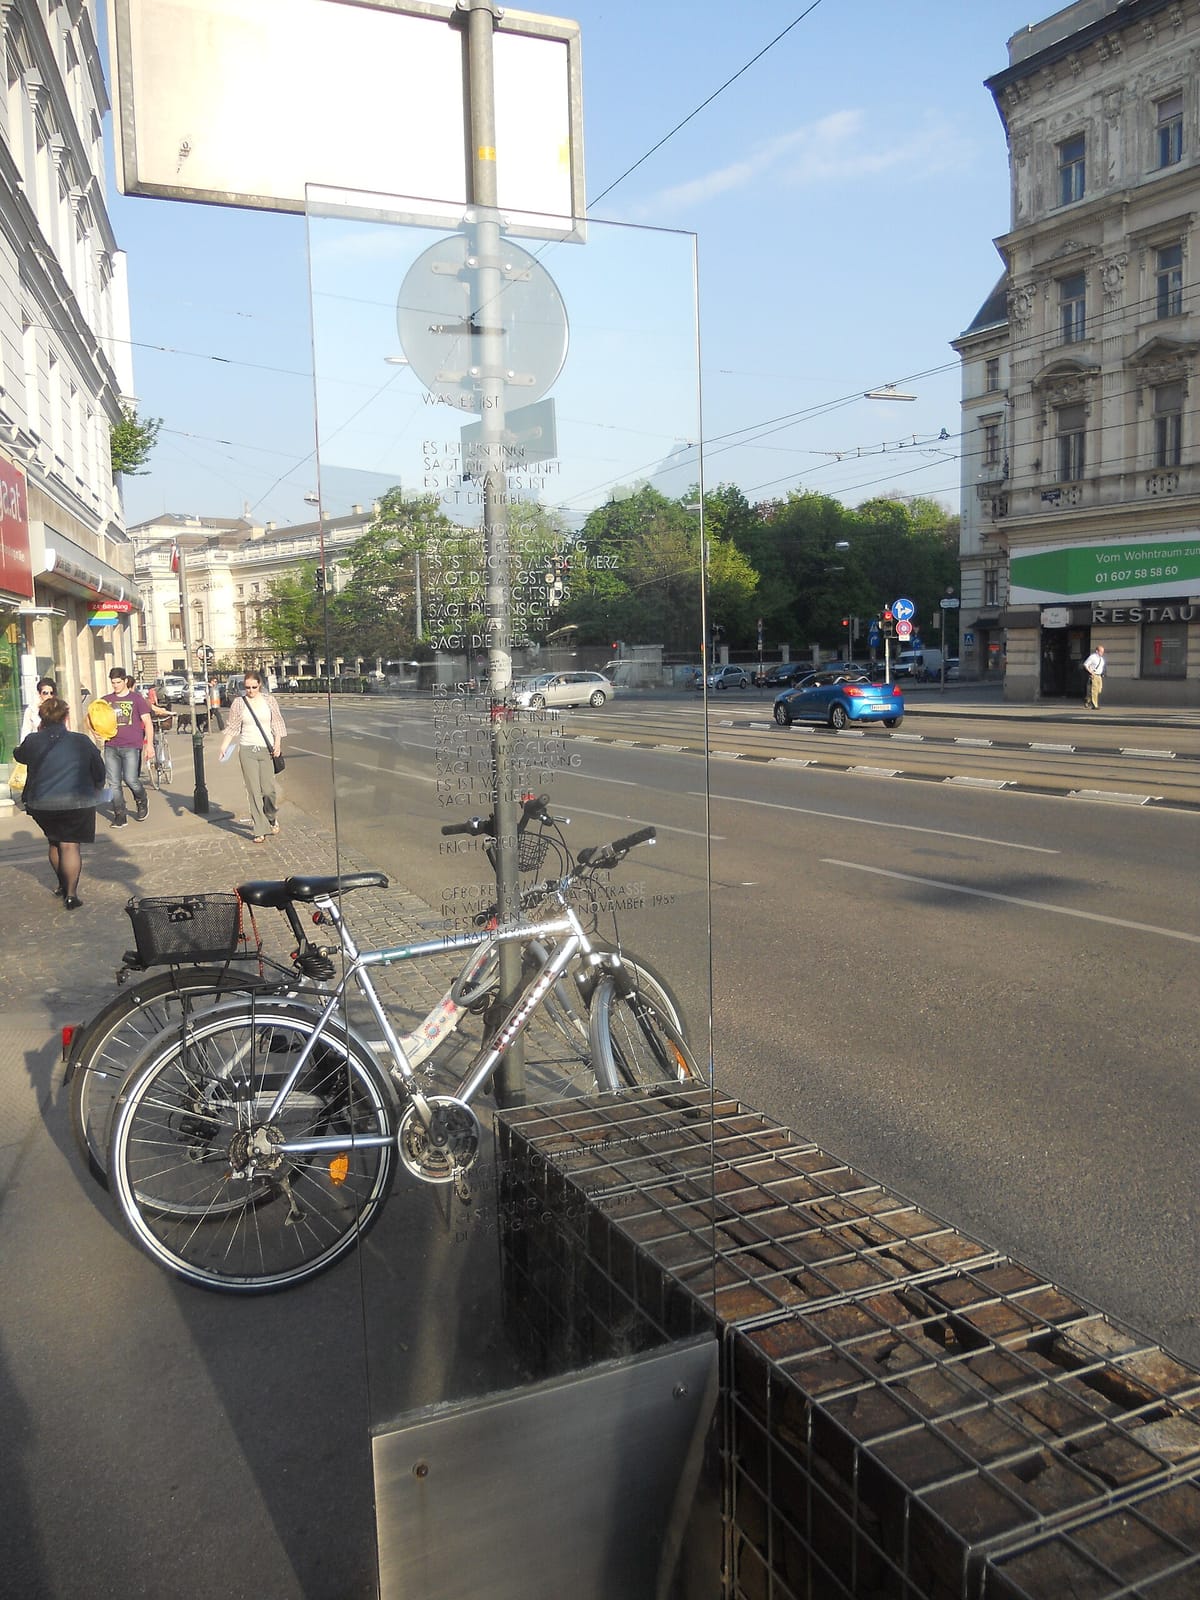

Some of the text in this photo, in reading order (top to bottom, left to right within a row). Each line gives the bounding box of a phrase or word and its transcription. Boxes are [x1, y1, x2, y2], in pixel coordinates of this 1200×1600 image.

[422, 392, 499, 409] WAS ES IST
[423, 441, 437, 455] ES
[445, 442, 461, 456] IST
[424, 458, 459, 471] SAGT
[424, 475, 439, 488] ES
[446, 475, 462, 489] IST
[508, 476, 523, 489] ES
[529, 476, 546, 489] IST
[1096, 552, 1120, 564] Vom
[1124, 549, 1182, 561] Wohntraum
[1095, 566, 1178, 583] 01 607 58 58 60
[1092, 605, 1194, 623] RESTAU
[533, 617, 551, 631] IST
[430, 635, 466, 649] SAGT
[472, 635, 492, 649] DIE
[432, 683, 448, 697] ES
[454, 682, 470, 697] IST
[435, 729, 469, 744] SAGT
[476, 728, 496, 743] DIE
[435, 746, 449, 760] ES
[457, 745, 472, 759] IST
[436, 761, 471, 776] SAGT
[477, 759, 497, 773] DIE
[436, 778, 451, 792] ES
[458, 777, 475, 791] IST
[482, 774, 512, 789] WAS
[539, 771, 556, 785] IST
[437, 793, 473, 808] SAGT
[479, 790, 498, 804] DIE
[439, 839, 478, 855] ERICH
[441, 903, 456, 917] IN
[443, 934, 457, 946] IN
